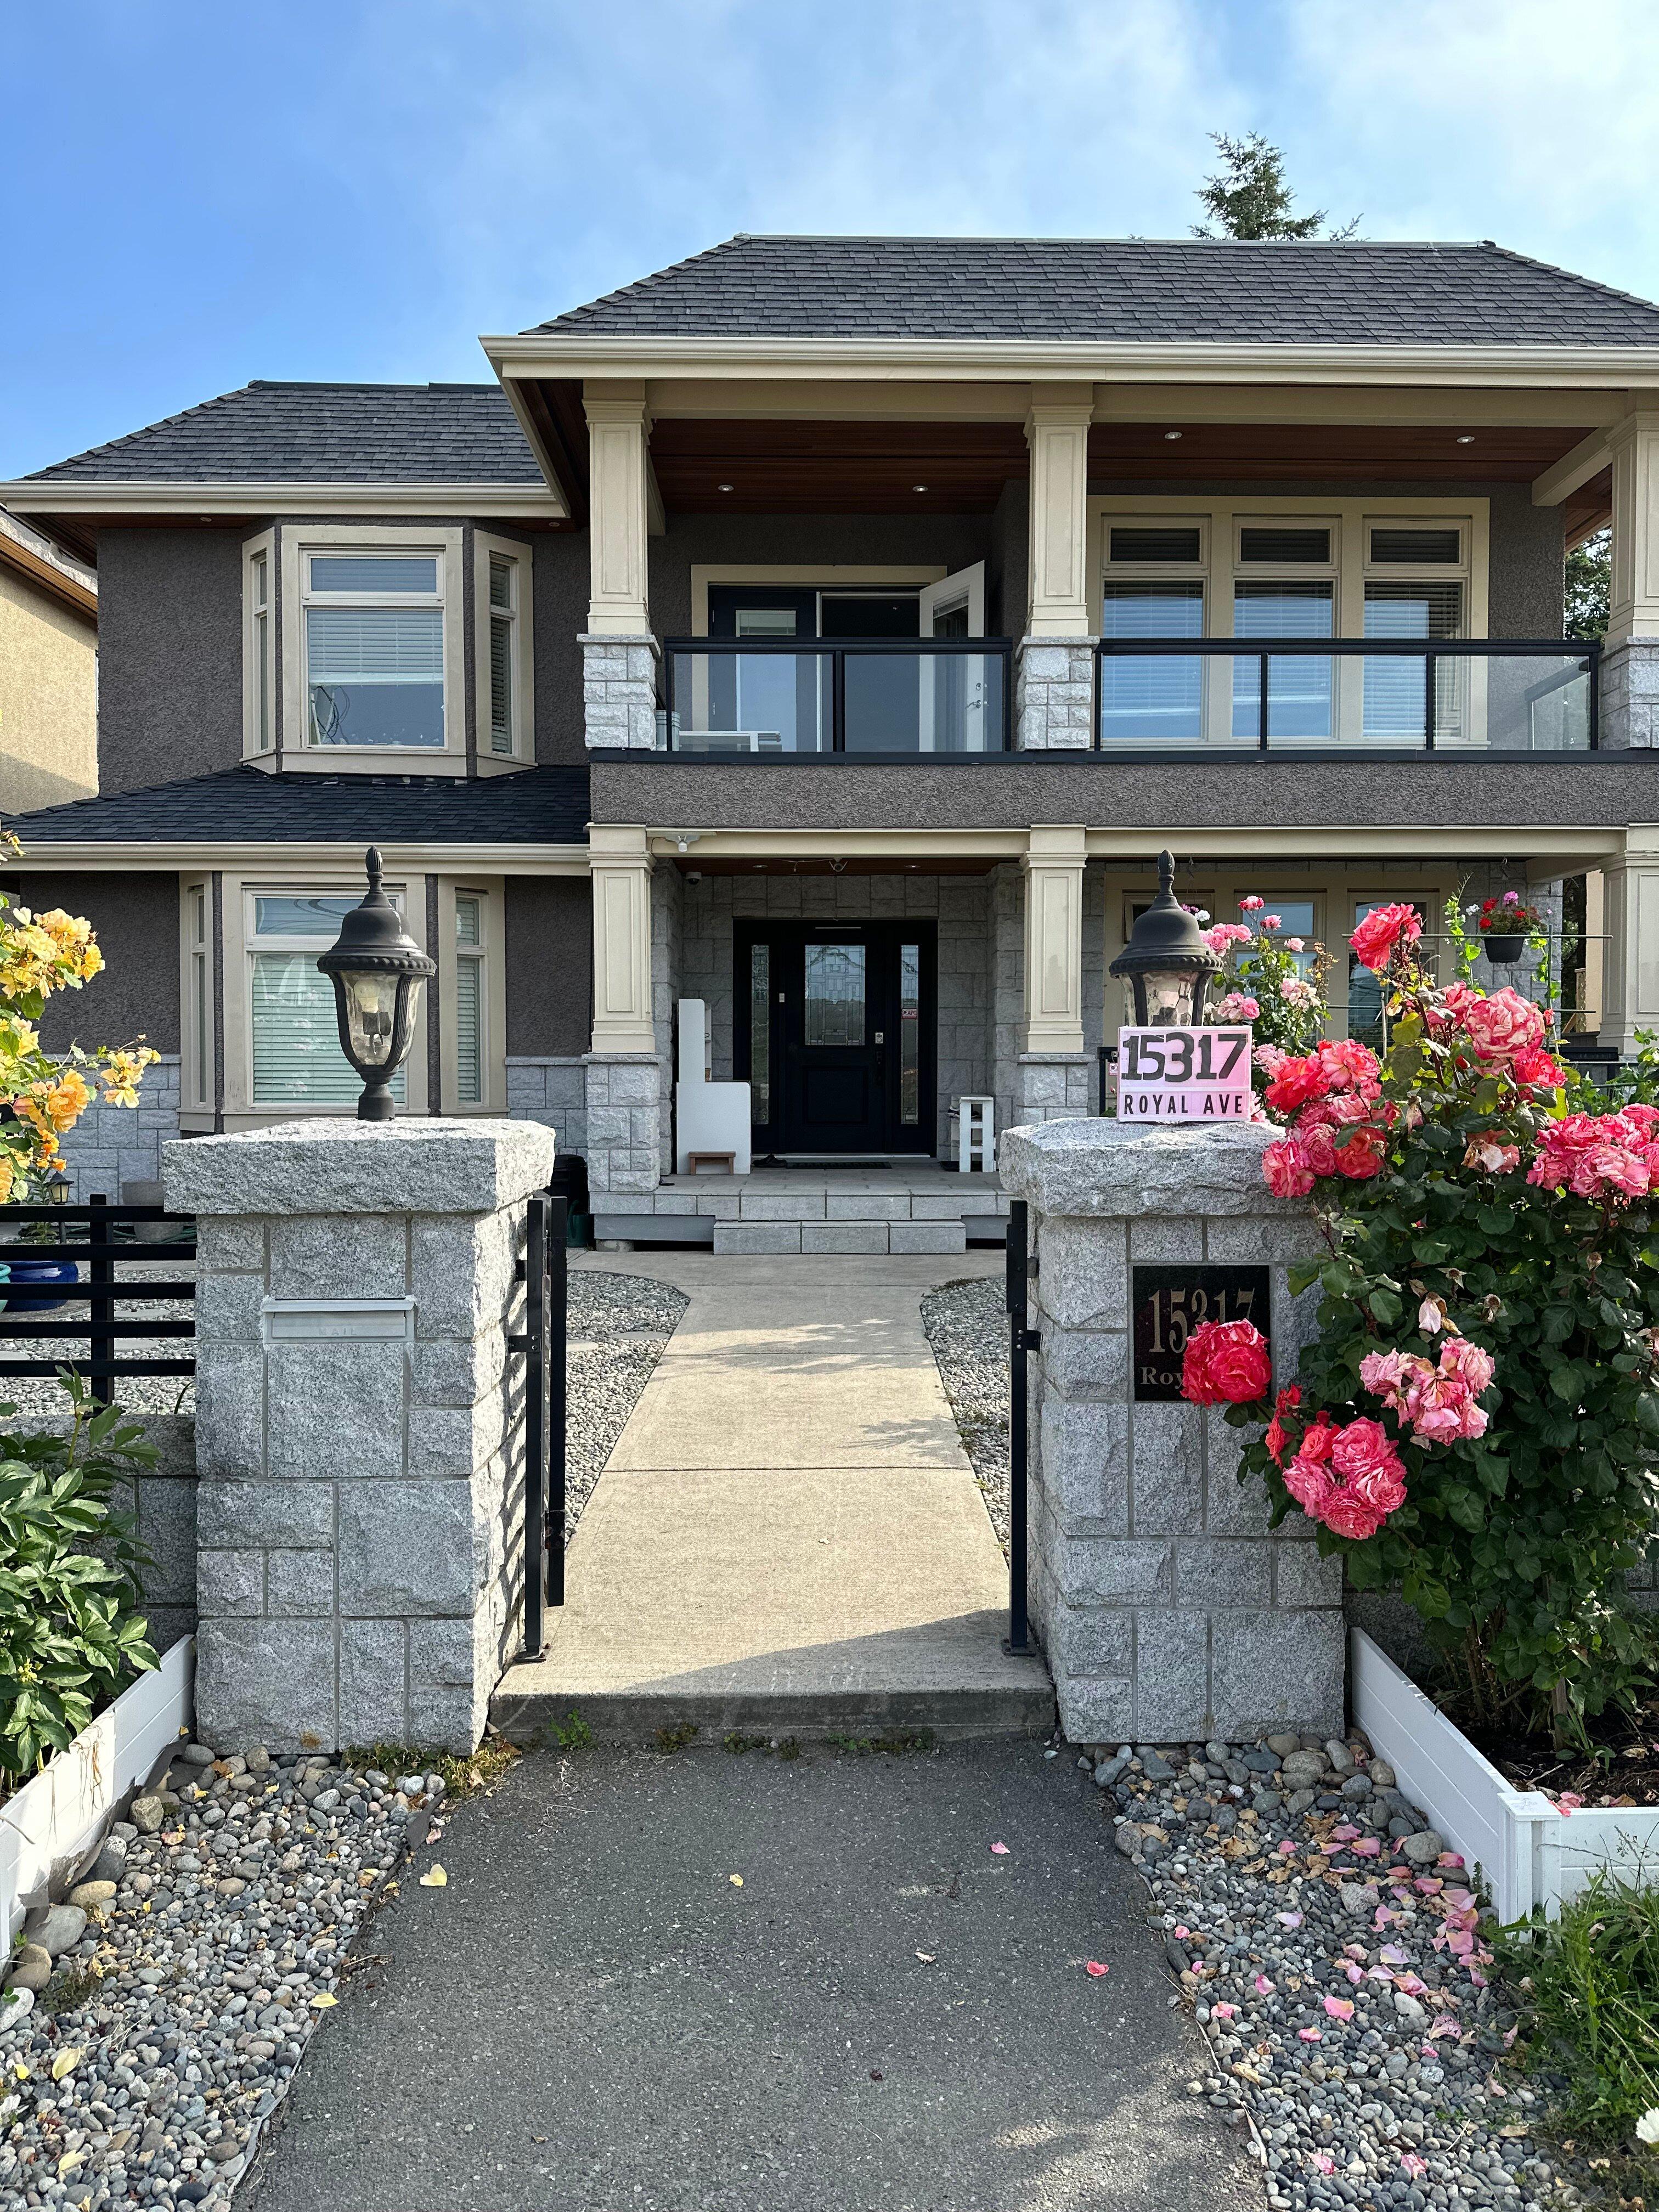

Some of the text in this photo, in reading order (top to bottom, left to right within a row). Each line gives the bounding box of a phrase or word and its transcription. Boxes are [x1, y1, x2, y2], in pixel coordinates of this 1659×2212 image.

[1121, 1032, 1248, 1082] 15317
[1124, 1094, 1243, 1115] ROYAL AVE
[1139, 1367, 1183, 1390] Roy
